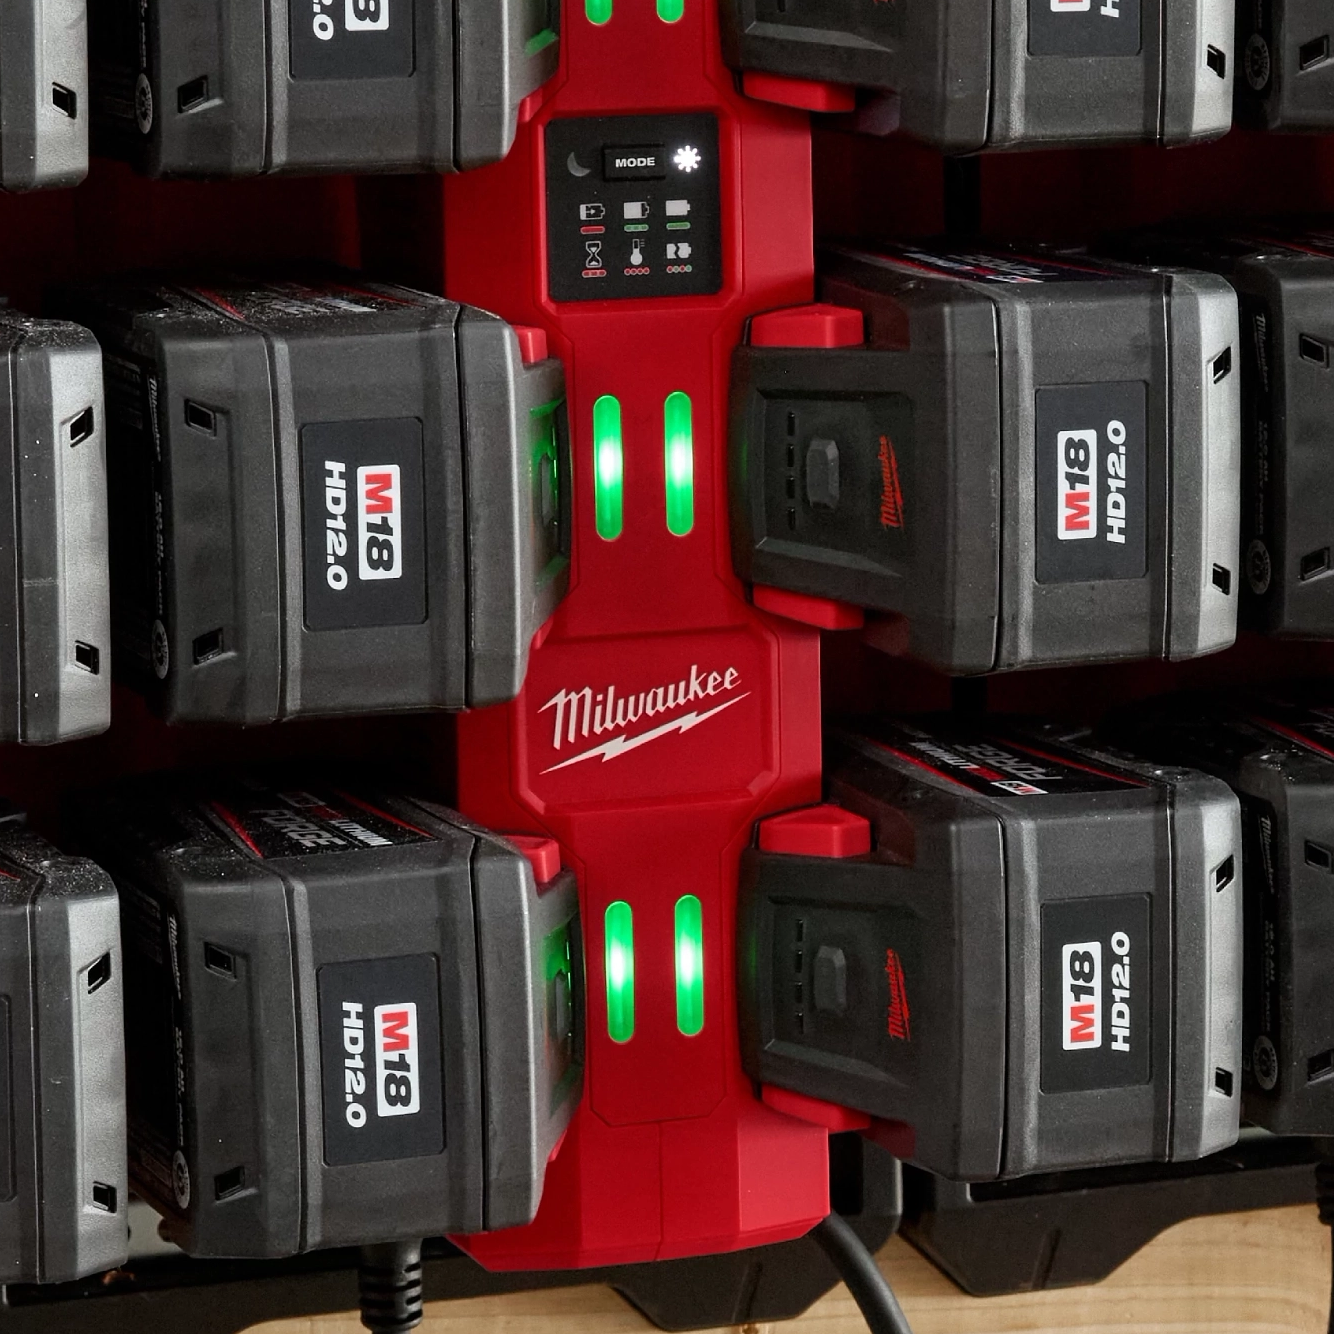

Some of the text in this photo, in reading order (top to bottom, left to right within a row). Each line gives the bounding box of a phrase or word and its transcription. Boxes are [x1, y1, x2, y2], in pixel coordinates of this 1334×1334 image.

[615, 157, 656, 168] MODE
[324, 460, 349, 591] HD12.0
[364, 472, 395, 573] M18
[1064, 437, 1091, 531] M18
[1106, 420, 1127, 544] HD12.0
[537, 665, 742, 750] Milwaukee
[1069, 950, 1096, 1044] M18
[1111, 931, 1131, 1052] HD12.0
[341, 1001, 367, 1128] HD12.0
[381, 1010, 412, 1108] M18
